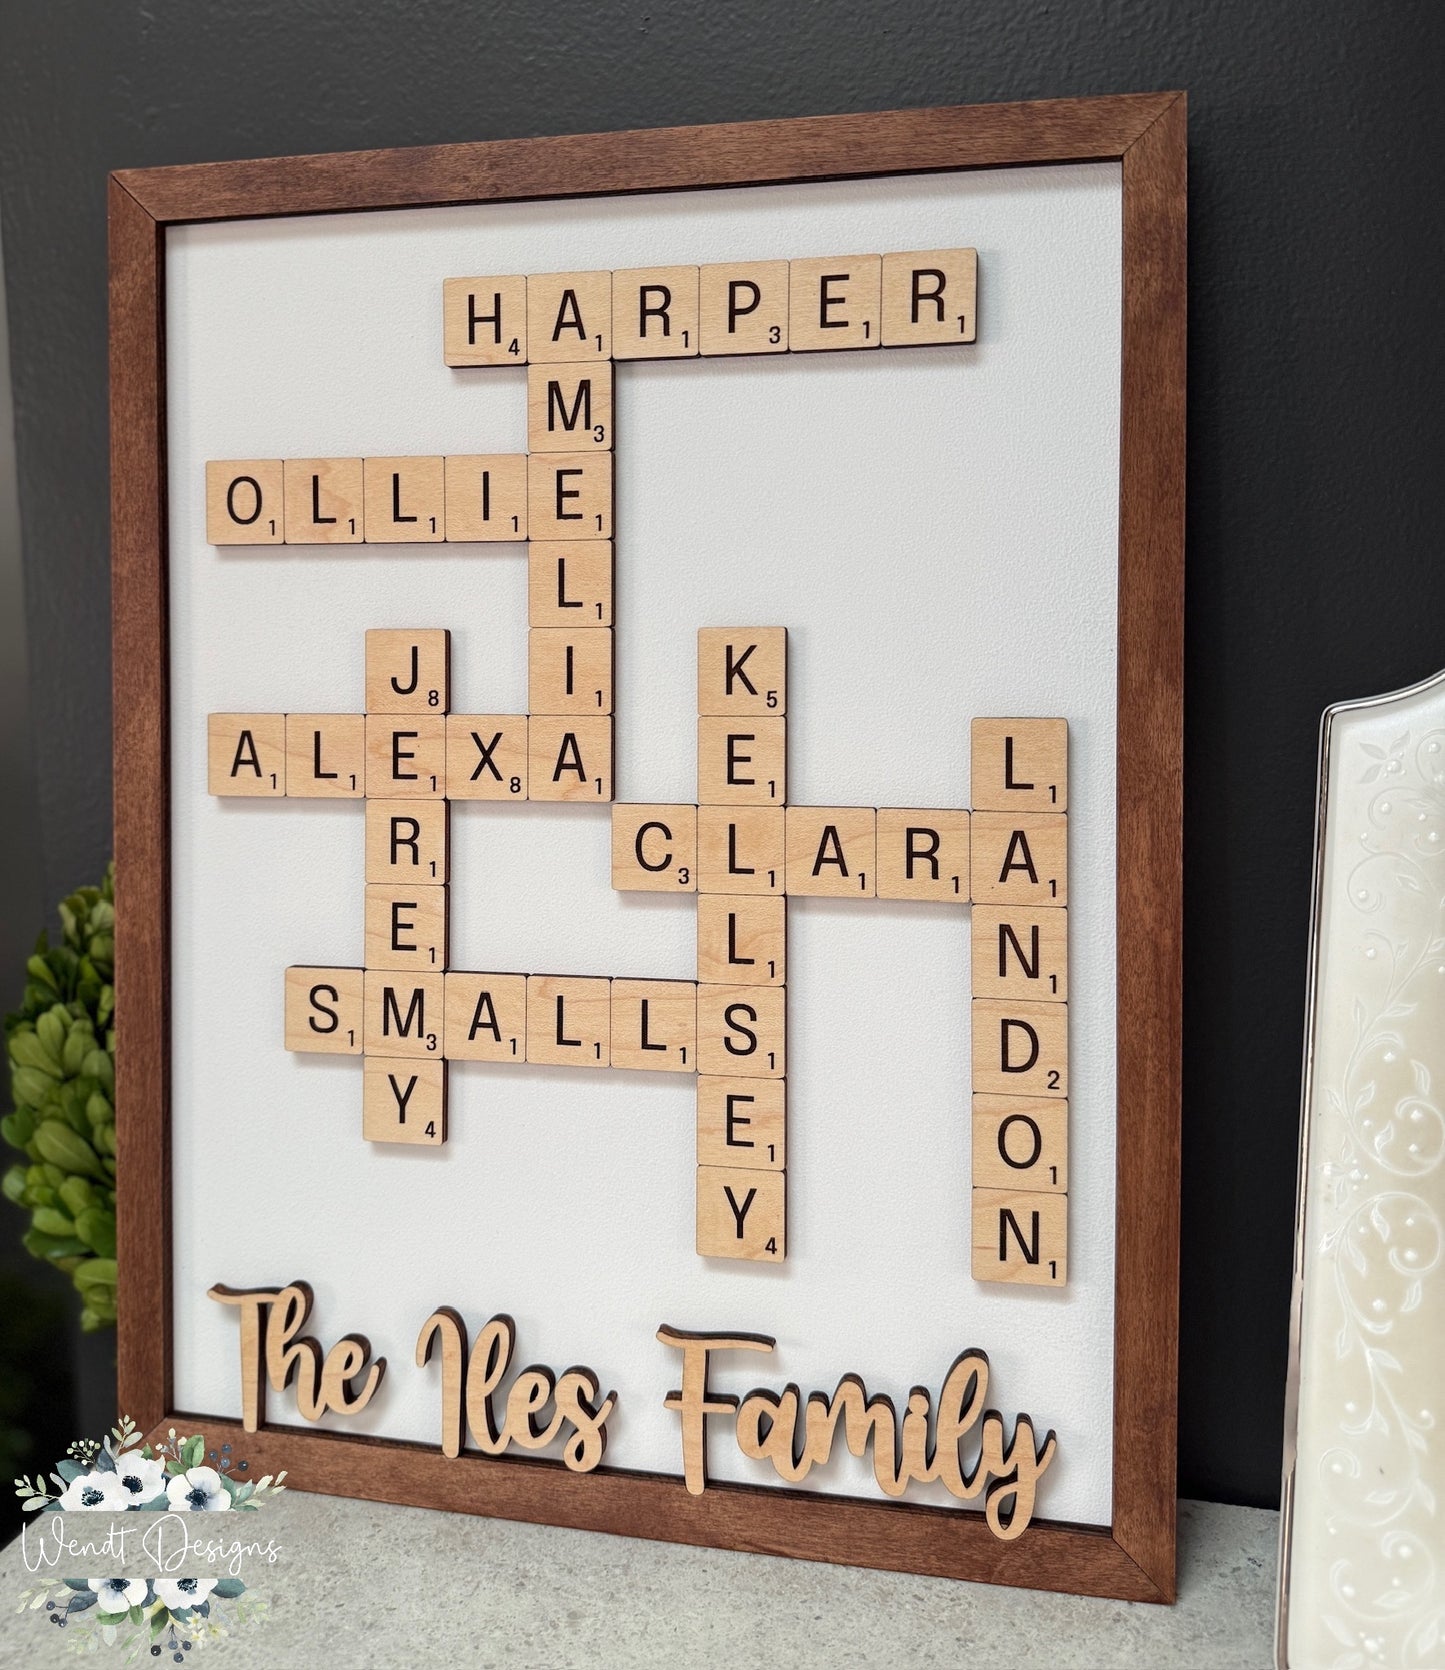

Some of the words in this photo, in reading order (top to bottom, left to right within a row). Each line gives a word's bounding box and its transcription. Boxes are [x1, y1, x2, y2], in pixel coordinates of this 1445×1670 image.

[468, 268, 947, 345] HARPER
[226, 468, 584, 525] OLLIE
[547, 288, 592, 783] AMELIA
[230, 729, 587, 783] ALEXA
[382, 645, 425, 1124] JEREMY
[635, 821, 1039, 884] CLARA
[308, 984, 758, 1056] SMALLS
[723, 644, 759, 1239] KELLSEY
[997, 736, 1042, 1265] LANDON
[207, 1280, 388, 1433] The
[416, 1306, 618, 1473] Iles
[655, 1323, 1057, 1541] Family
